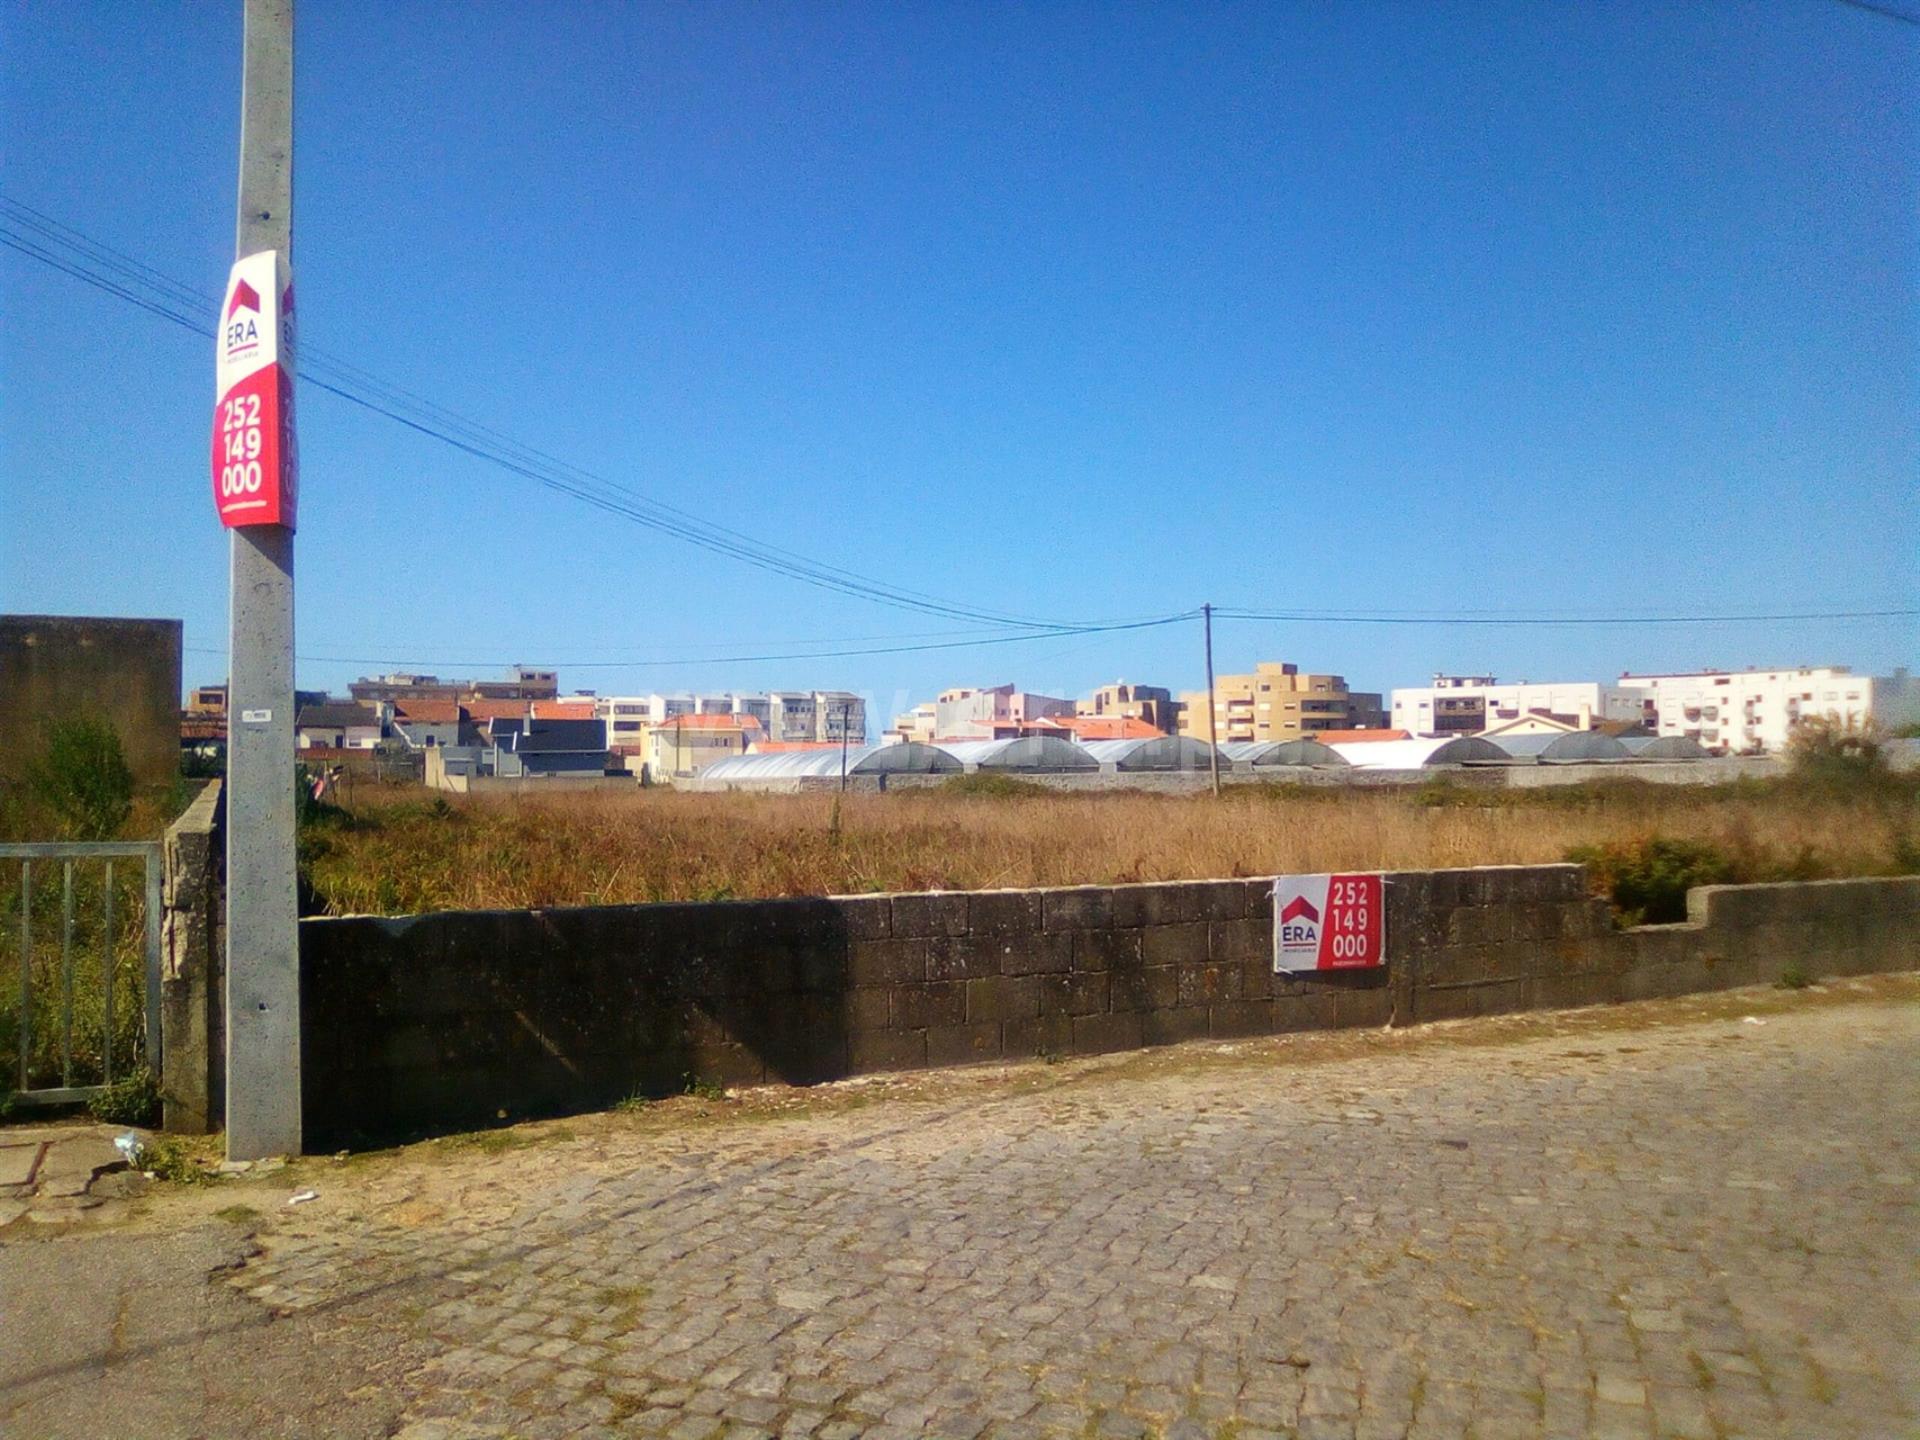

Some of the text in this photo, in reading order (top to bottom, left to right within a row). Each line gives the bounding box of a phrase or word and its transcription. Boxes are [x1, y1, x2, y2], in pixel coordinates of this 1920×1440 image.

[227, 318, 259, 348] ERA
[223, 393, 261, 432] 252
[224, 427, 261, 464] 149
[222, 461, 262, 497] 000
[1333, 881, 1368, 905] 252
[1332, 908, 1368, 931] 149
[1282, 926, 1316, 941] ERA
[1332, 934, 1367, 958] 000
